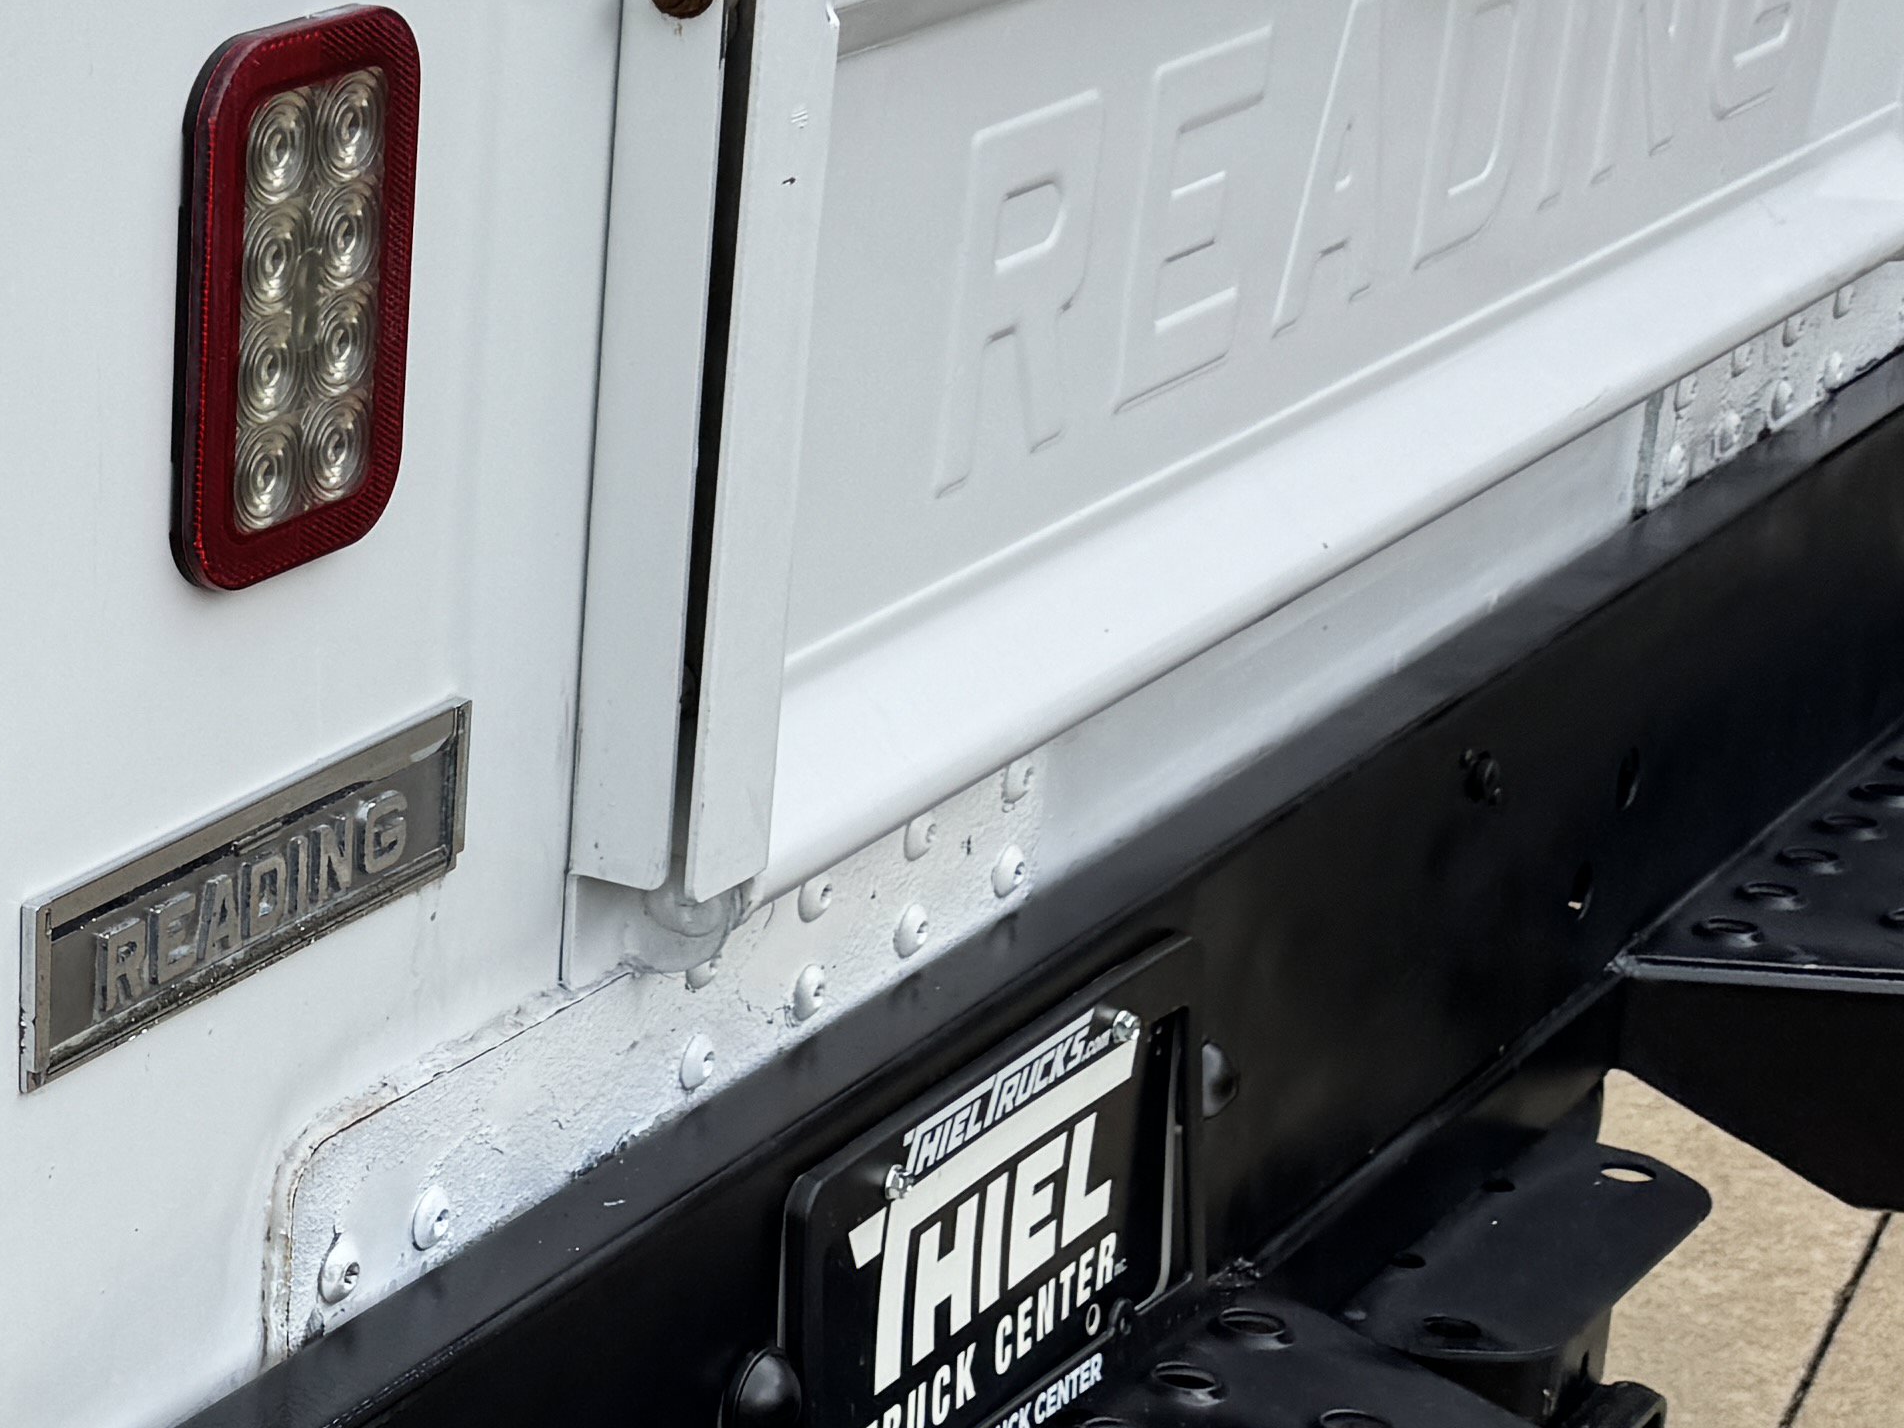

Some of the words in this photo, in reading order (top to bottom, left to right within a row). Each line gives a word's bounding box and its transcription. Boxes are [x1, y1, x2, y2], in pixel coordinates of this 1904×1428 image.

[94, 789, 408, 1012] READING
[848, 1038, 1137, 1396] THIEL
[995, 1232, 1117, 1376] CENTER
[1034, 1352, 1104, 1425] CENTER
